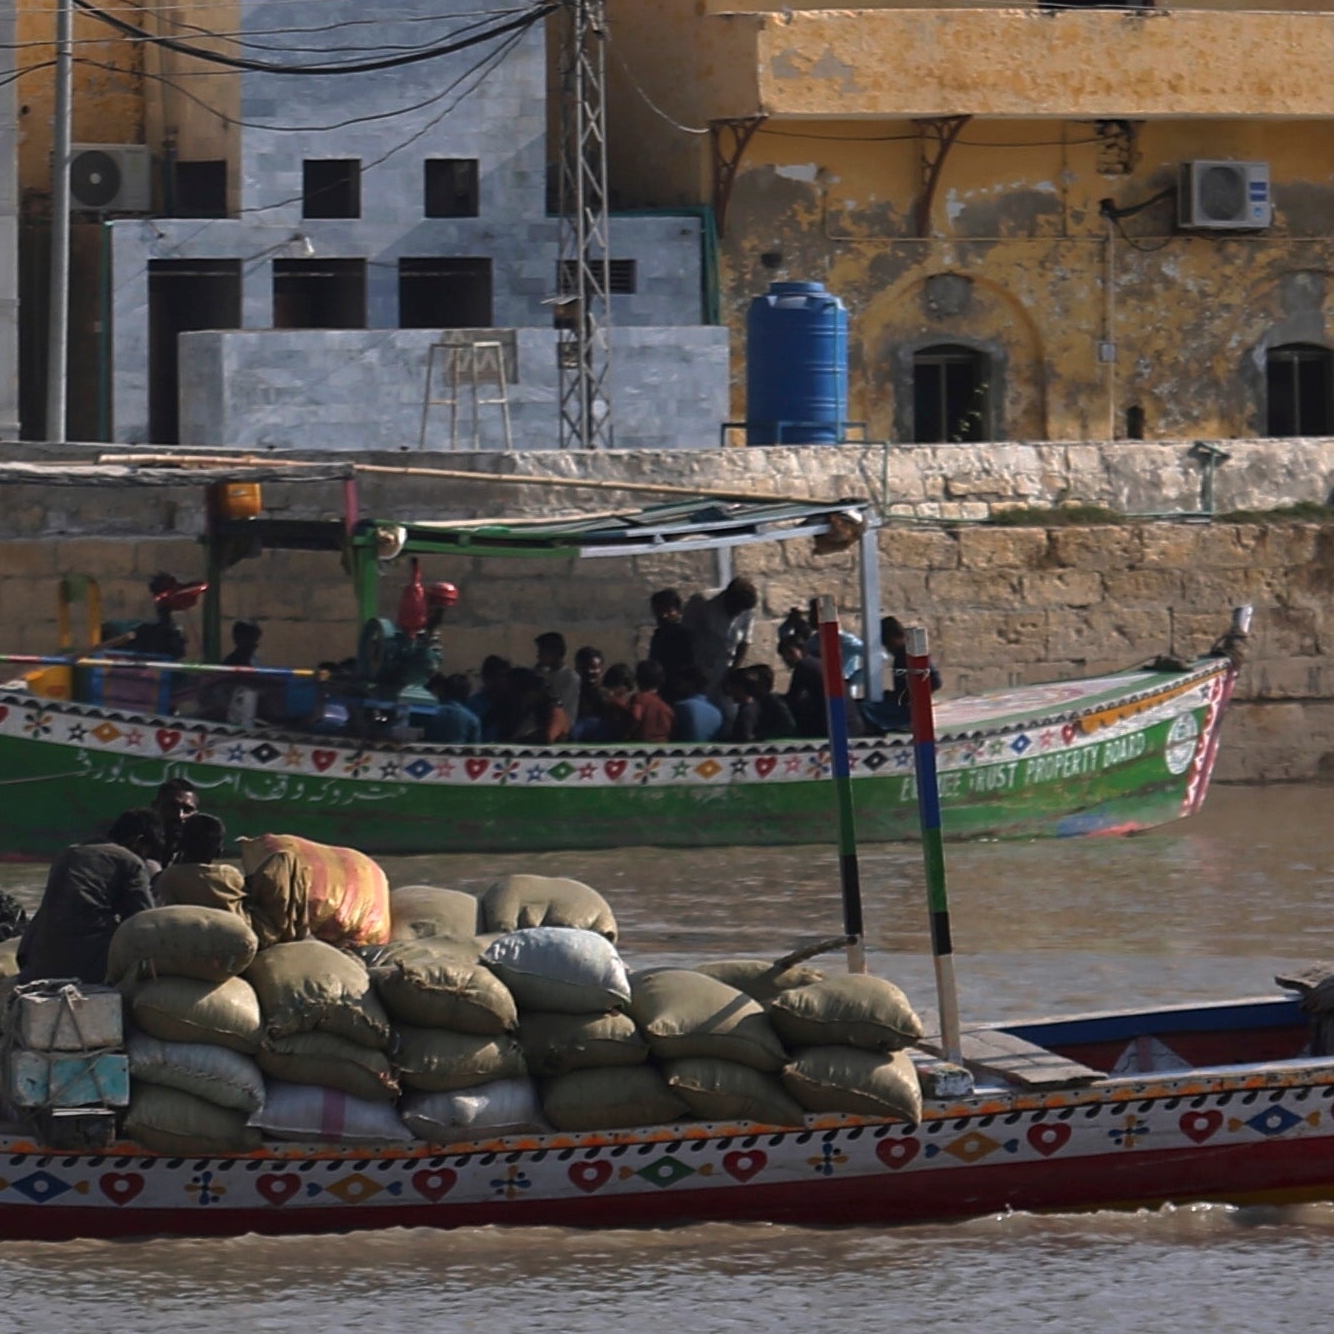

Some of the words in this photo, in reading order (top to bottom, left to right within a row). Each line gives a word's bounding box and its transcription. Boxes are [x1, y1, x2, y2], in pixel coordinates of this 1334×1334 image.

[969, 763, 1019, 792] TRUST
[1025, 745, 1102, 785] PROPERTY
[1103, 732, 1147, 769] BOARD
